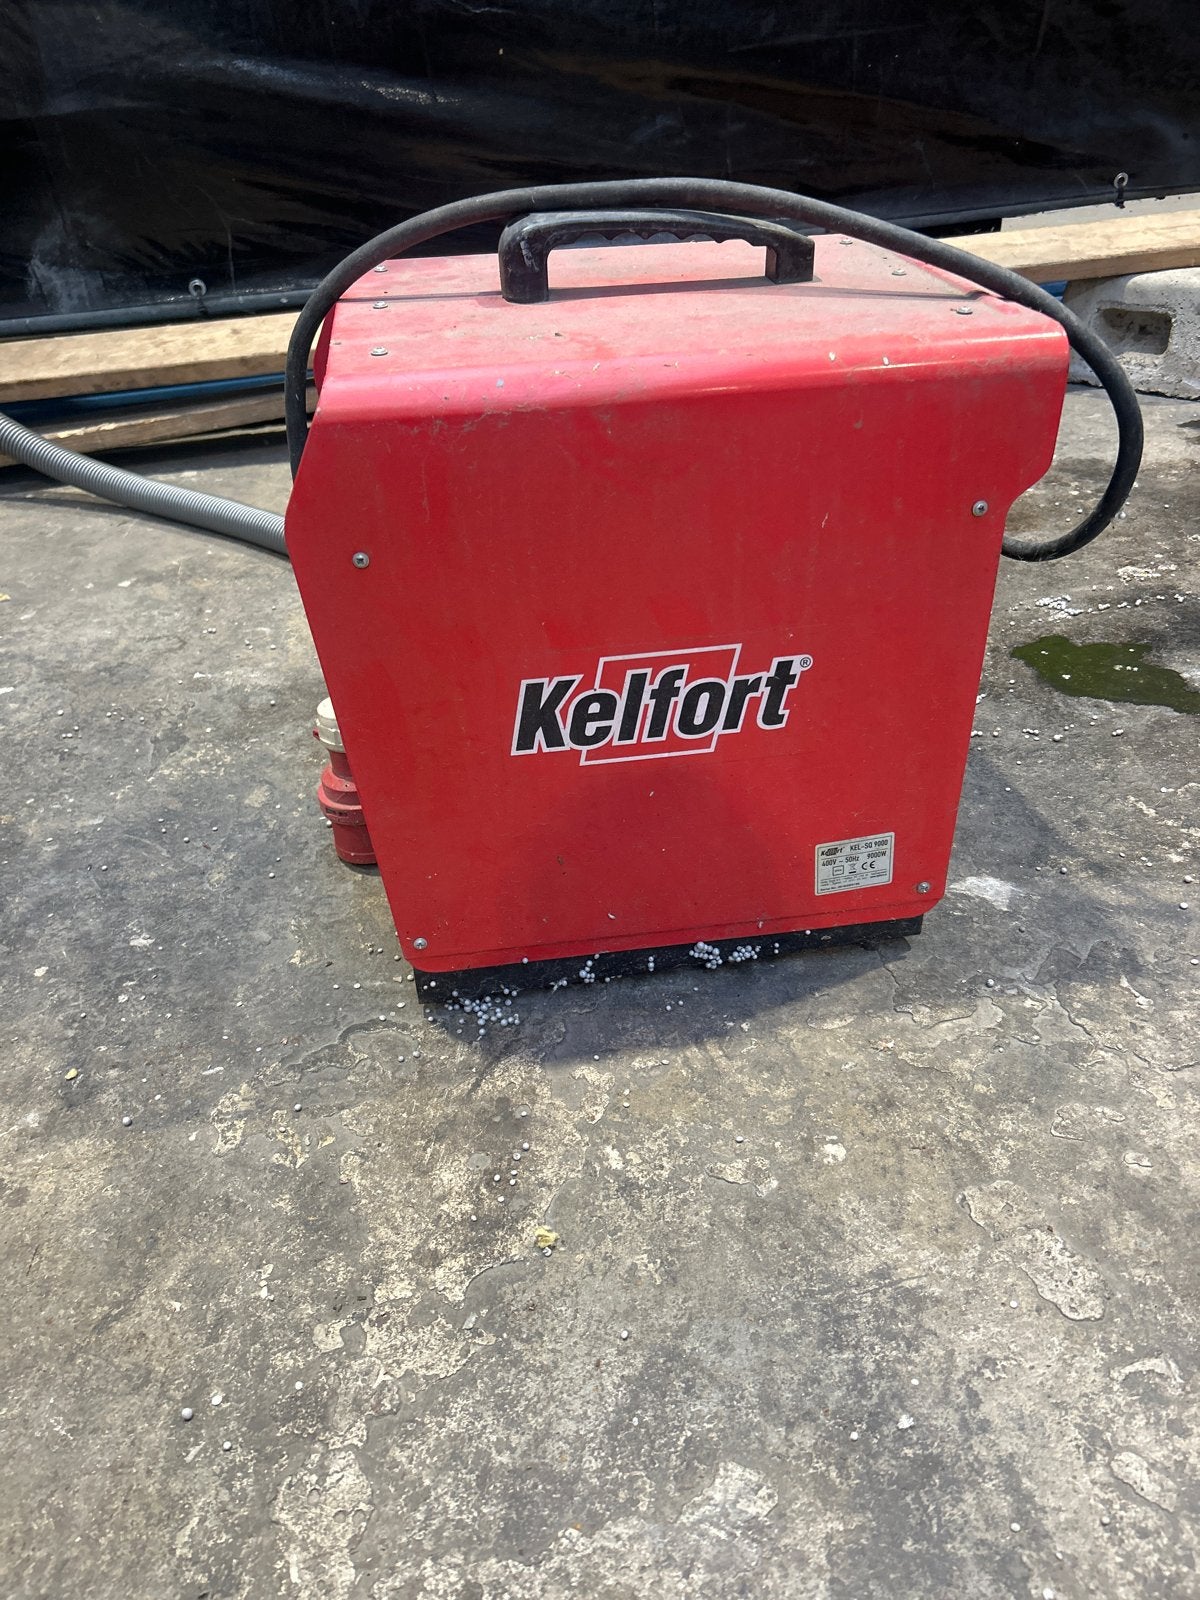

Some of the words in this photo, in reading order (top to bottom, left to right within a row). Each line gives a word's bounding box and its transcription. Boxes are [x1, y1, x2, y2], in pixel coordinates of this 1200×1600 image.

[873, 839, 889, 848] 9000
[821, 859, 837, 867] 400V
[845, 855, 860, 863] 50Hz
[866, 850, 887, 860] 9000W
